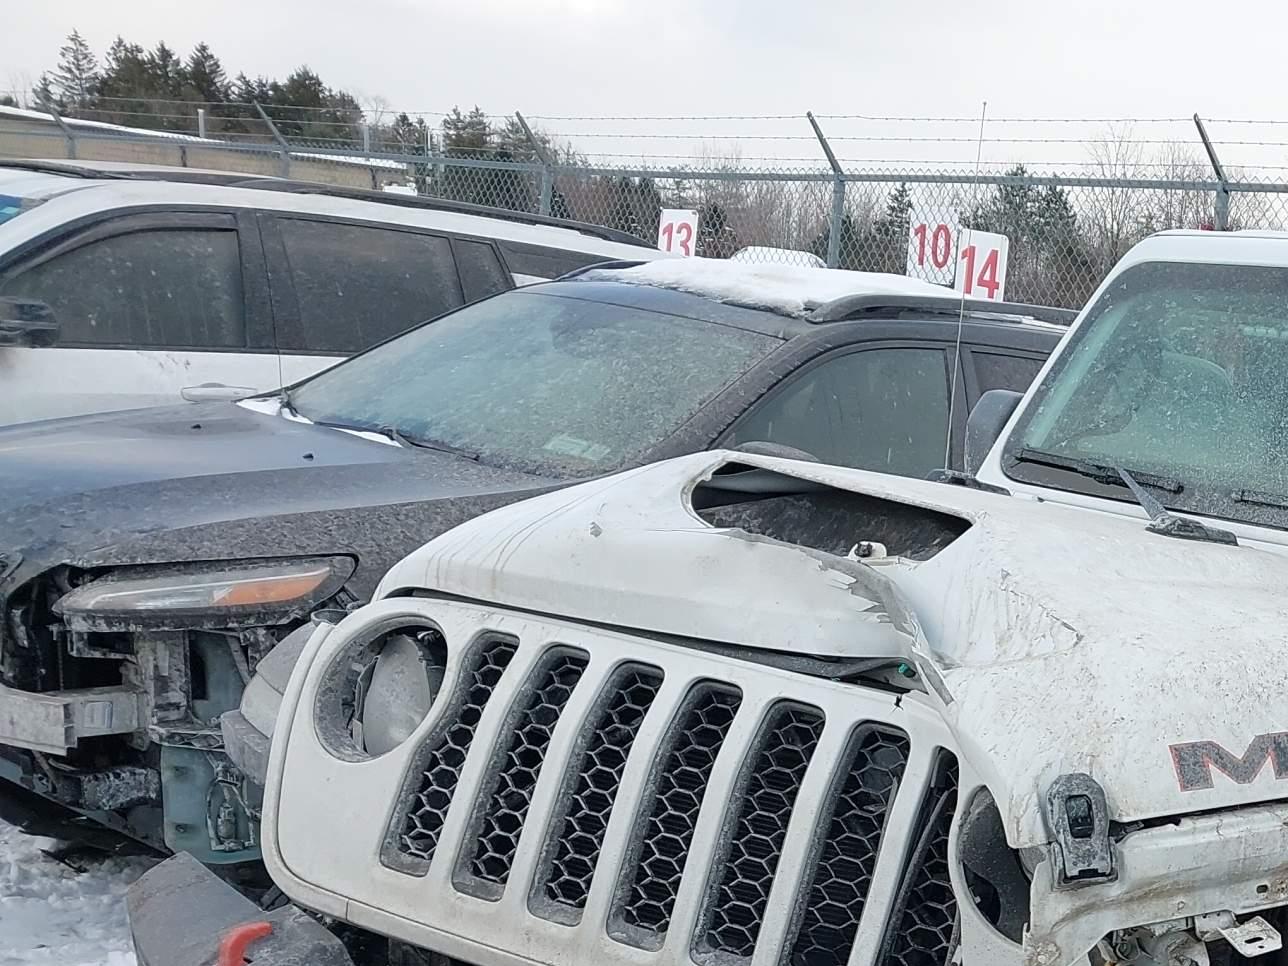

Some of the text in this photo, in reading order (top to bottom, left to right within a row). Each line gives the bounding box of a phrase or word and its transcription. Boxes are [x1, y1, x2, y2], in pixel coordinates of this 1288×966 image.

[662, 222, 692, 256] 13
[914, 223, 951, 269] 10
[961, 245, 1000, 299] 14
